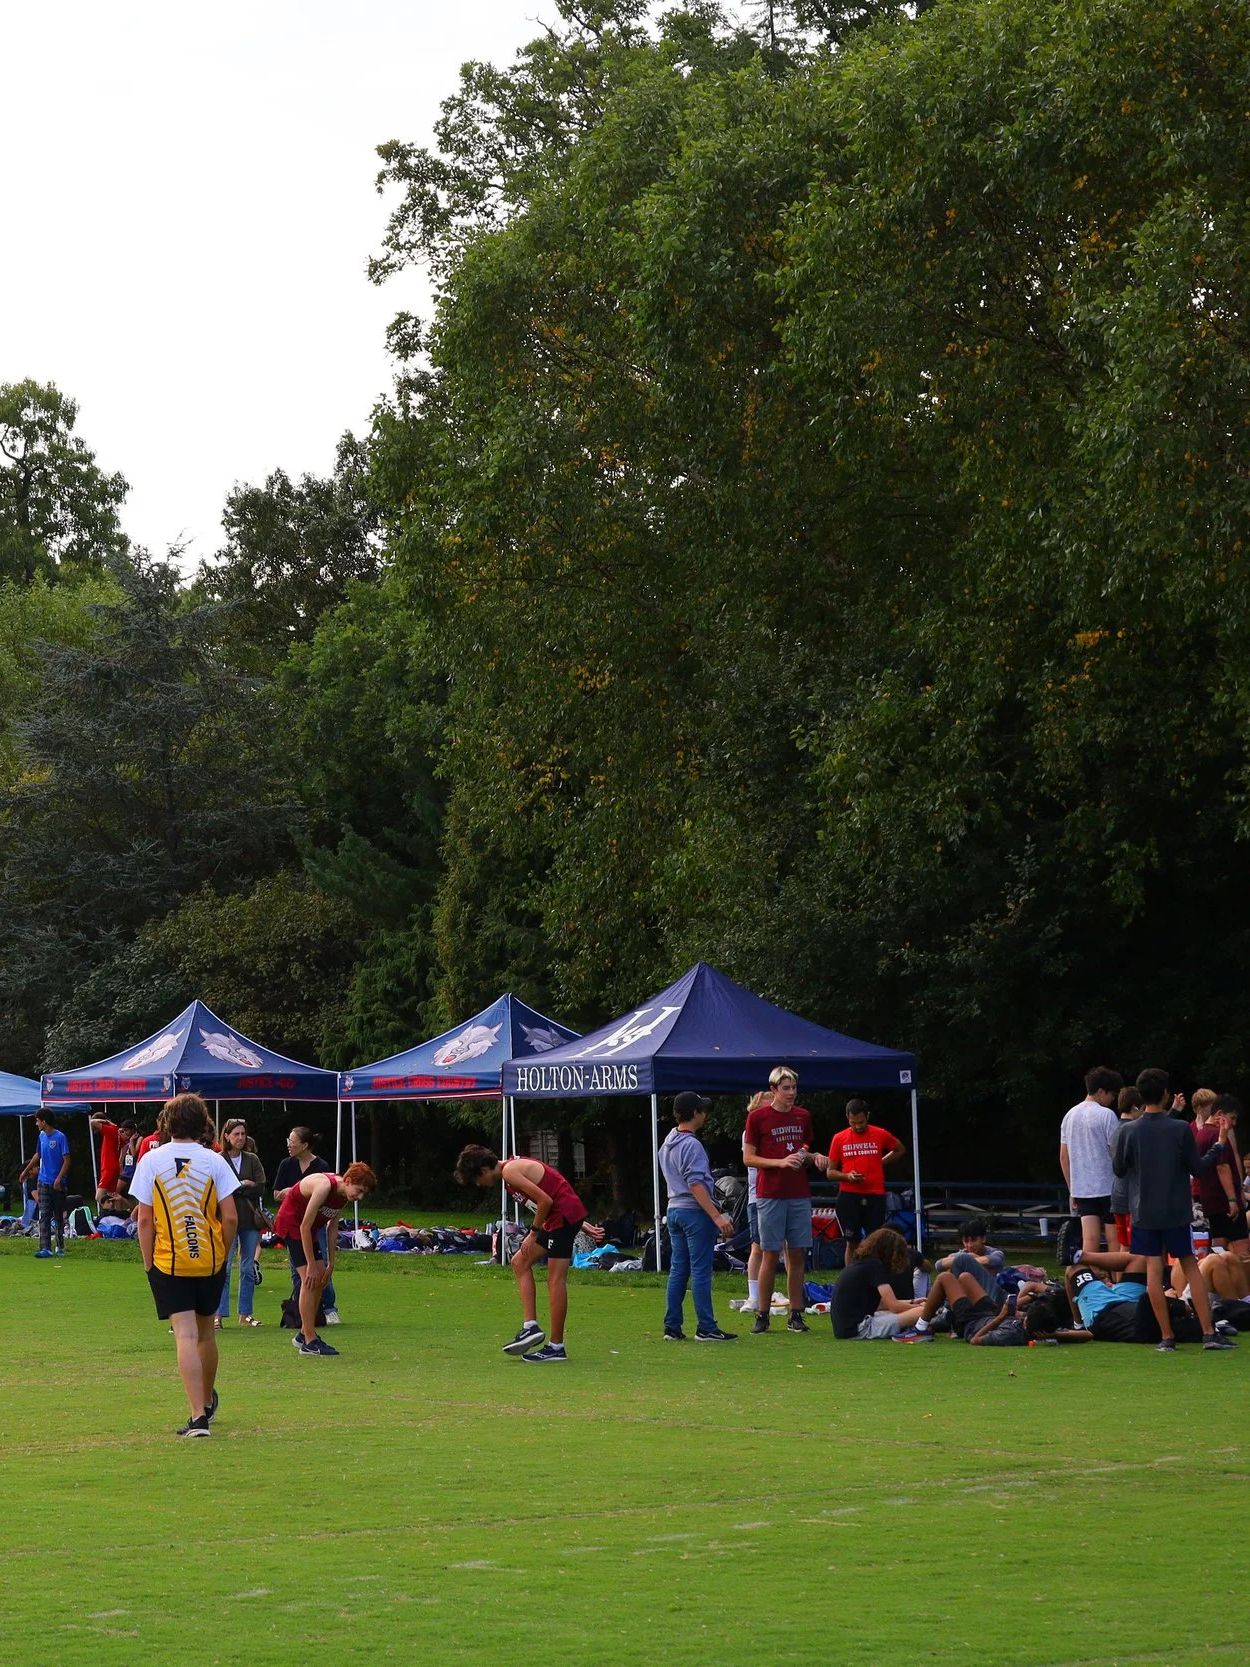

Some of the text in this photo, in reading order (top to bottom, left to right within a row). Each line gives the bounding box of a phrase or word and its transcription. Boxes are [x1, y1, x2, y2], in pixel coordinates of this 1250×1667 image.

[516, 1064, 638, 1091] HOLTON-ARMS
[771, 1125, 804, 1136] SIDWELL
[842, 1142, 878, 1151] SIDWELL
[184, 1215, 200, 1259] FALCONS
